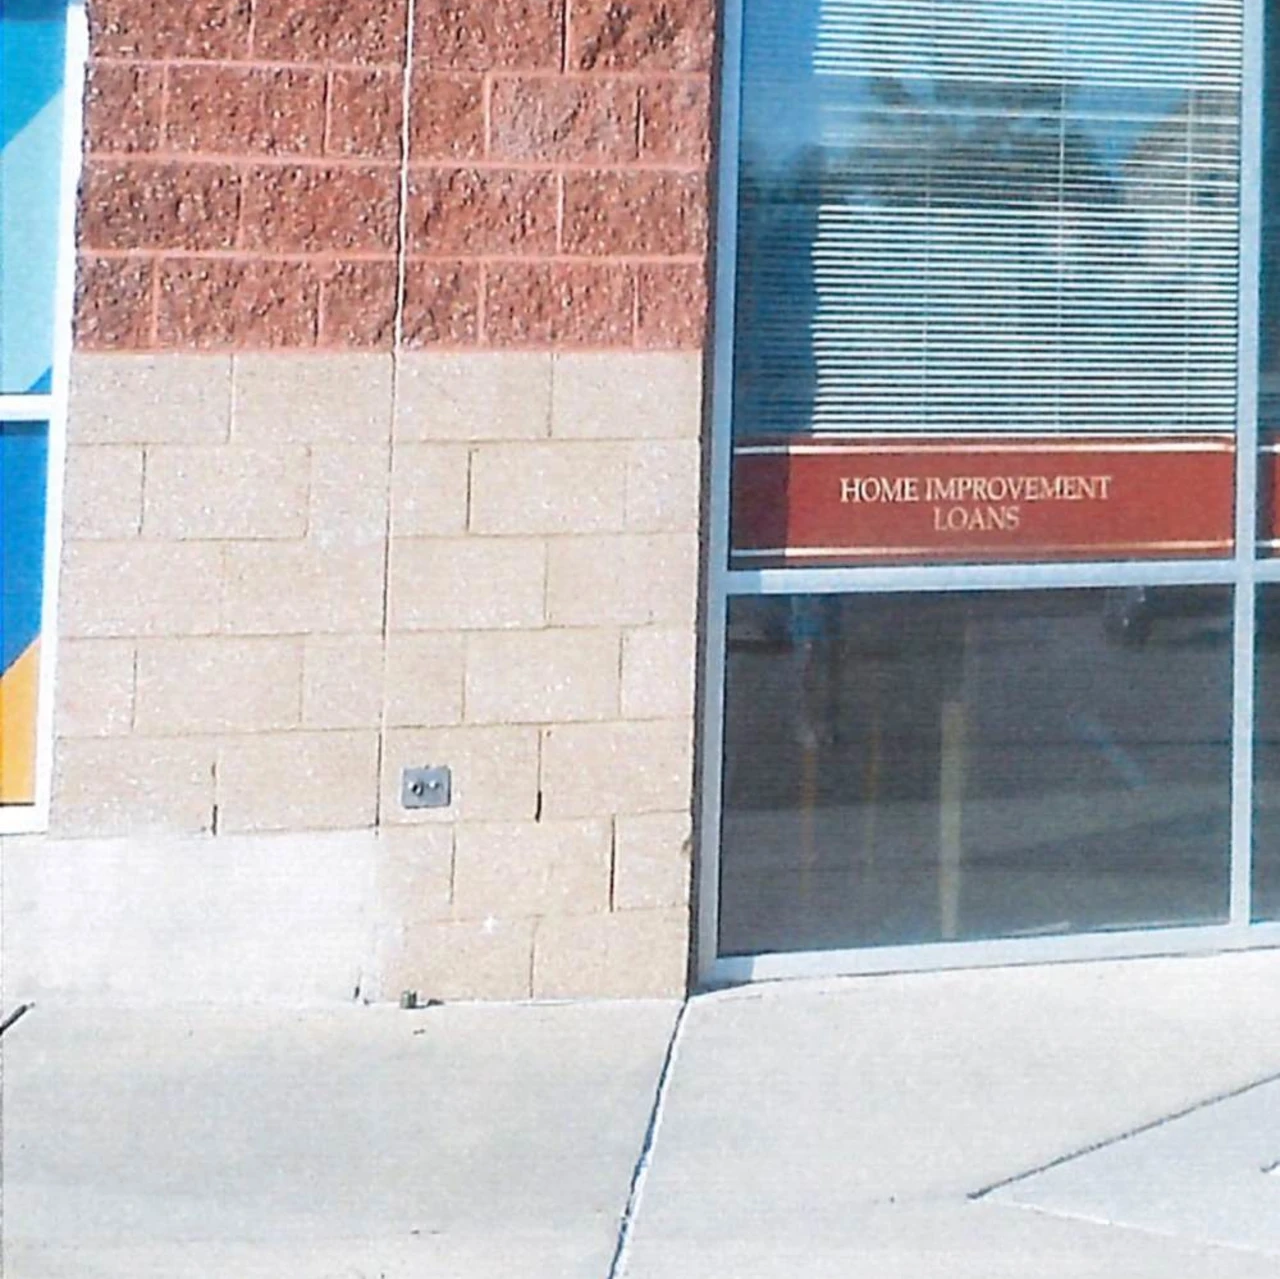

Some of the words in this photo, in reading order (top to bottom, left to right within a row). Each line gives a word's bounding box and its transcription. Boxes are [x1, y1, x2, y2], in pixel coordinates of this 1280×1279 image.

[840, 477, 919, 503] HOME
[925, 475, 1112, 500] IMPROVEMENT
[933, 506, 1021, 531] LOANS
